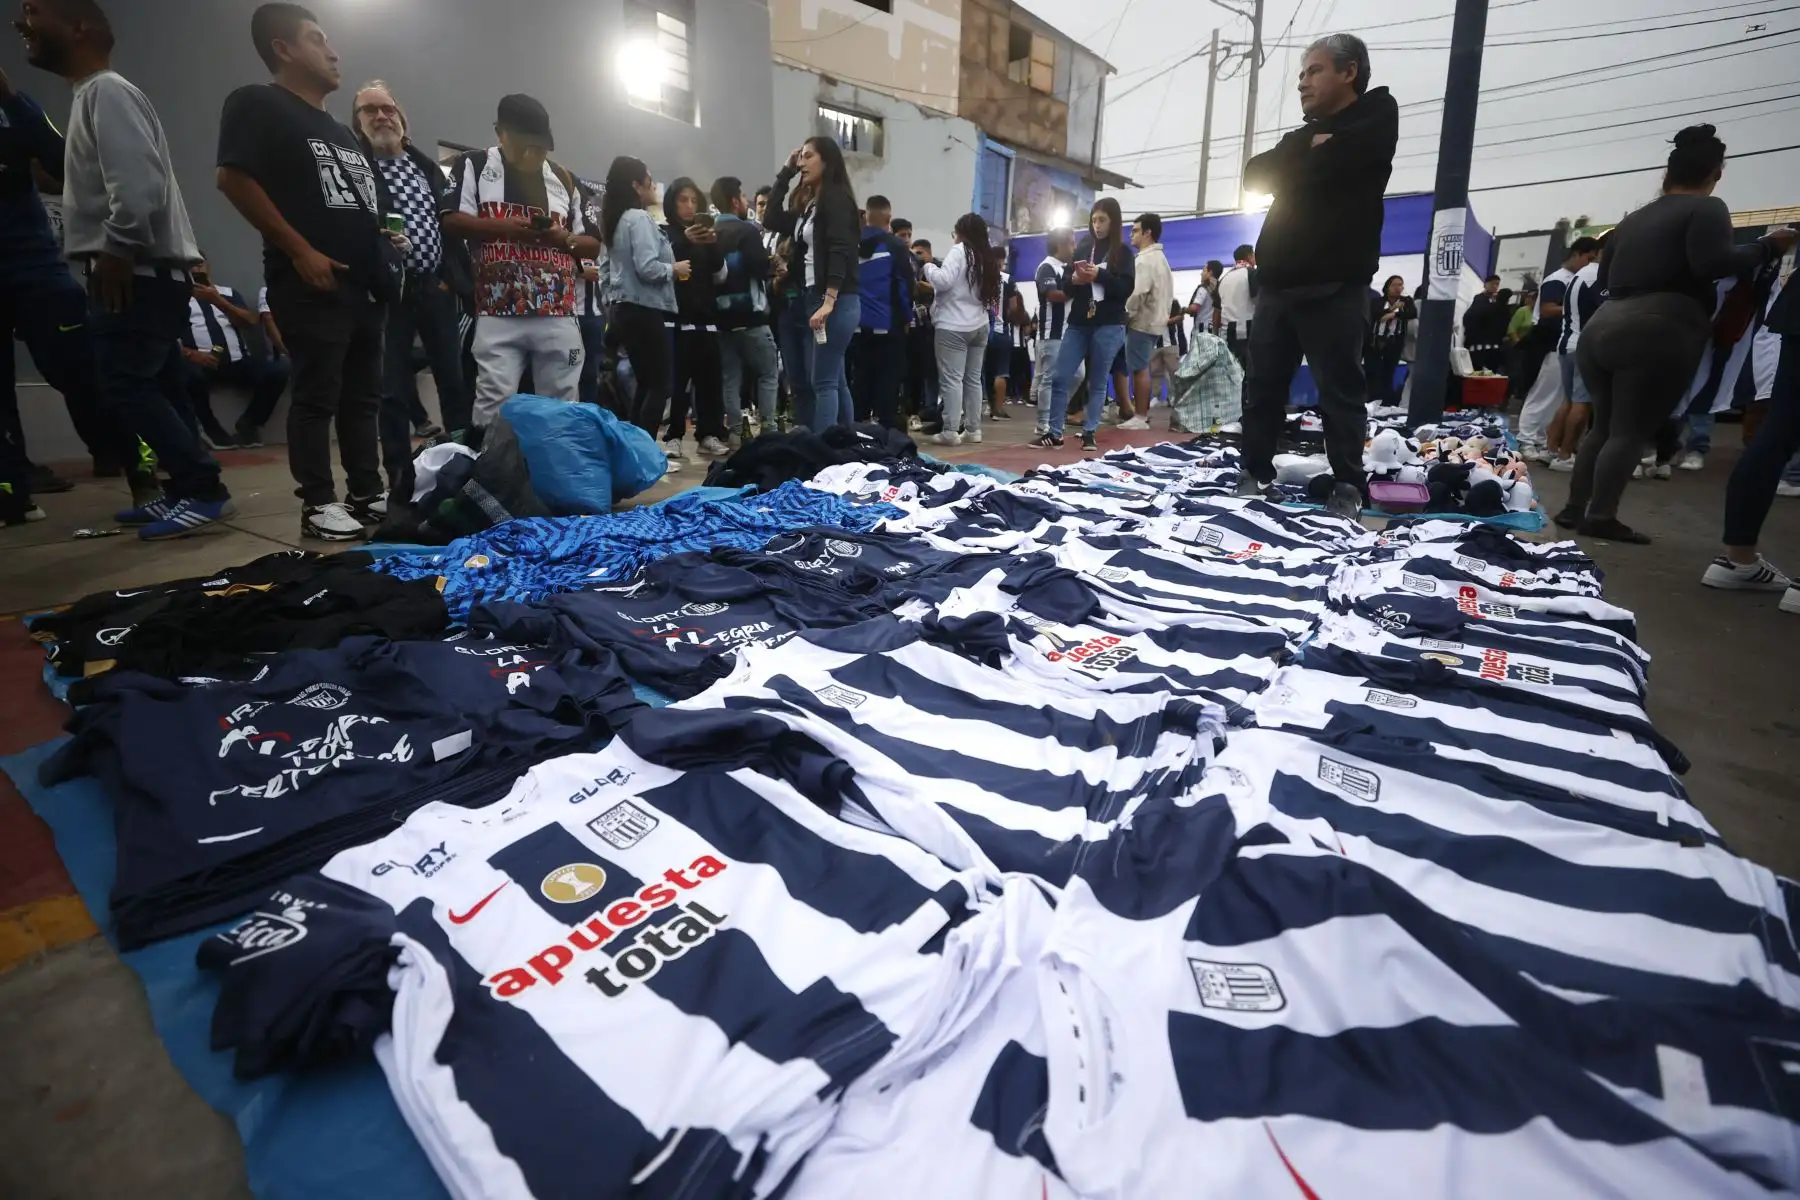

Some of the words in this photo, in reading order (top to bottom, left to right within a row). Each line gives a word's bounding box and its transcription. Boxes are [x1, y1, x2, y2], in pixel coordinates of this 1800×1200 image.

[652, 622, 680, 634] LA
[497, 654, 528, 668] LA
[1047, 635, 1121, 663] auesta
[1516, 662, 1551, 685] otal
[569, 768, 631, 804] GLOR
[489, 855, 728, 998] apuesta
[584, 900, 728, 998] total
